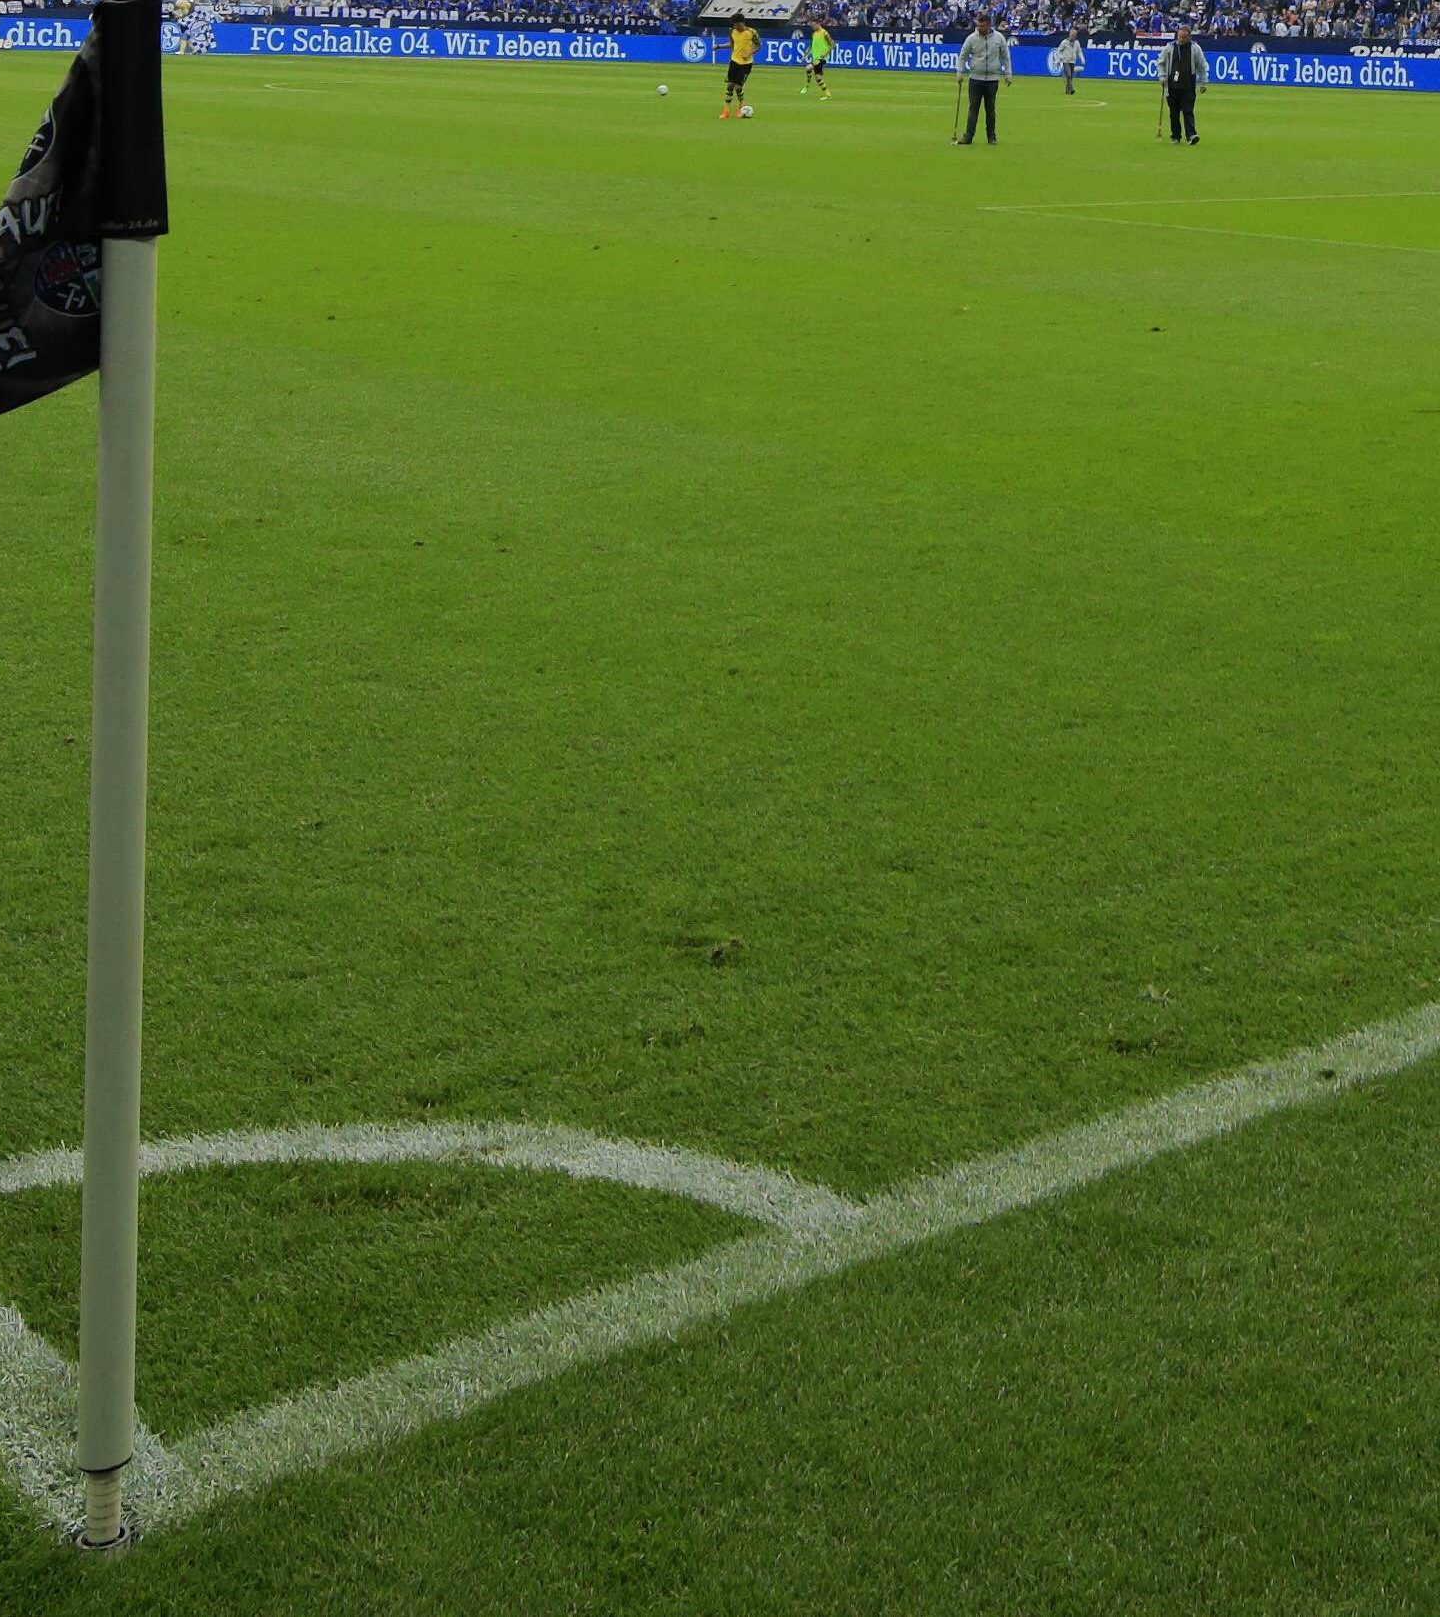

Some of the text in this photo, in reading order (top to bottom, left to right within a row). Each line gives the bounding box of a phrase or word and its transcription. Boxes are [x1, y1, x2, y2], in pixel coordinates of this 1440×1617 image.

[9, 21, 81, 50] dich.
[251, 26, 627, 59] FC Schalke 04. Wir leben dich.
[766, 40, 959, 69] FC 04. Wir leben
[1107, 52, 1134, 77] FC
[1216, 55, 1244, 81] 04.
[1250, 56, 1290, 84] Wir
[1296, 56, 1354, 86] leben
[1360, 59, 1414, 88] dich.
